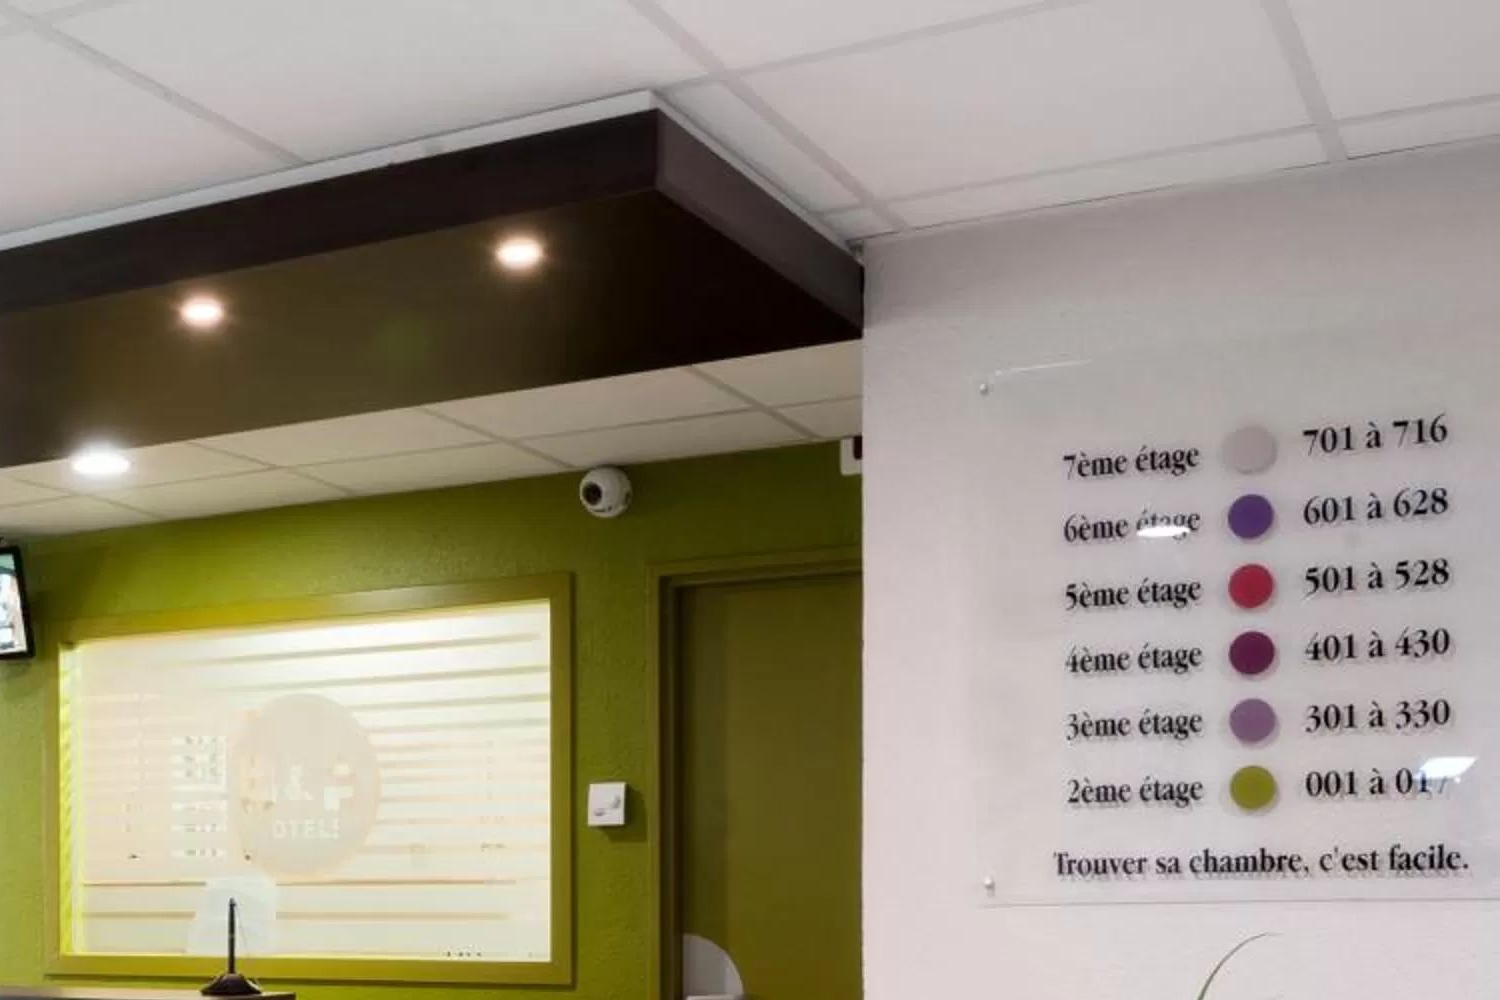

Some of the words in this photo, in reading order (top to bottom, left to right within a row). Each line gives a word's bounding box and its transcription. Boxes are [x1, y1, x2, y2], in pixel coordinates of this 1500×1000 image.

[1064, 452, 1127, 479] 7ème
[1135, 445, 1199, 476] étage
[1303, 427, 1353, 456] 701
[1366, 423, 1383, 449] à
[1393, 415, 1447, 445] 716
[1064, 515, 1128, 542] 6ème
[1136, 511, 1200, 540] étage
[1304, 496, 1354, 524] 601
[1367, 493, 1382, 519] à
[1393, 488, 1448, 517] 628
[1065, 585, 1129, 610] 5ème
[1137, 578, 1201, 607] étage
[1304, 565, 1355, 595] 501
[1368, 563, 1383, 589] à
[1395, 559, 1449, 589] 528
[1066, 650, 1129, 674] 4ème
[1138, 644, 1202, 674] étage
[1305, 633, 1356, 660] 401
[1369, 630, 1385, 657] à
[1395, 628, 1450, 657] 430
[1066, 715, 1130, 739] 3ème
[1139, 709, 1202, 738] étage
[1306, 704, 1356, 732] 301
[1369, 701, 1384, 727] à
[1396, 699, 1450, 728] 330
[1068, 779, 1131, 803] 2ème
[1140, 775, 1203, 805] étage
[1305, 770, 1357, 797] 001
[1369, 771, 1384, 794] à
[1054, 851, 1147, 876] Trouver
[1156, 858, 1182, 874] sa
[1190, 849, 1309, 875] chambre,
[1320, 847, 1378, 871] c'est
[1388, 844, 1469, 871] facile.
